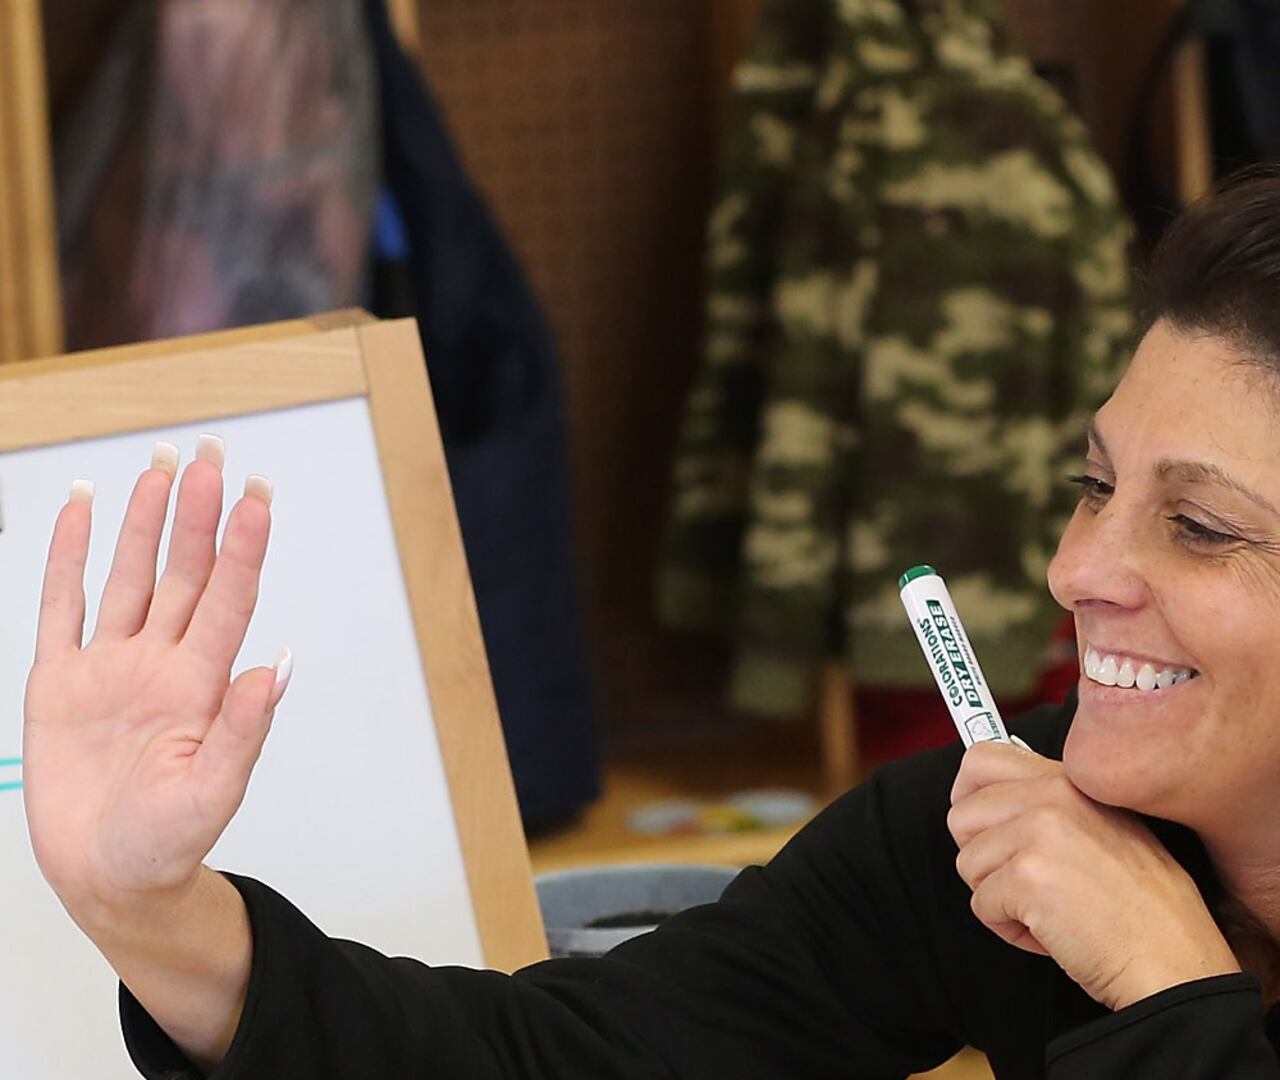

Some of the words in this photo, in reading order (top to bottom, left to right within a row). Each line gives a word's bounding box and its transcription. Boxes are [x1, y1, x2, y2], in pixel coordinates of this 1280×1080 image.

[928, 605, 962, 660] ERASE
[920, 618, 963, 706] COLORATIONS
[955, 668, 980, 702] DRY
